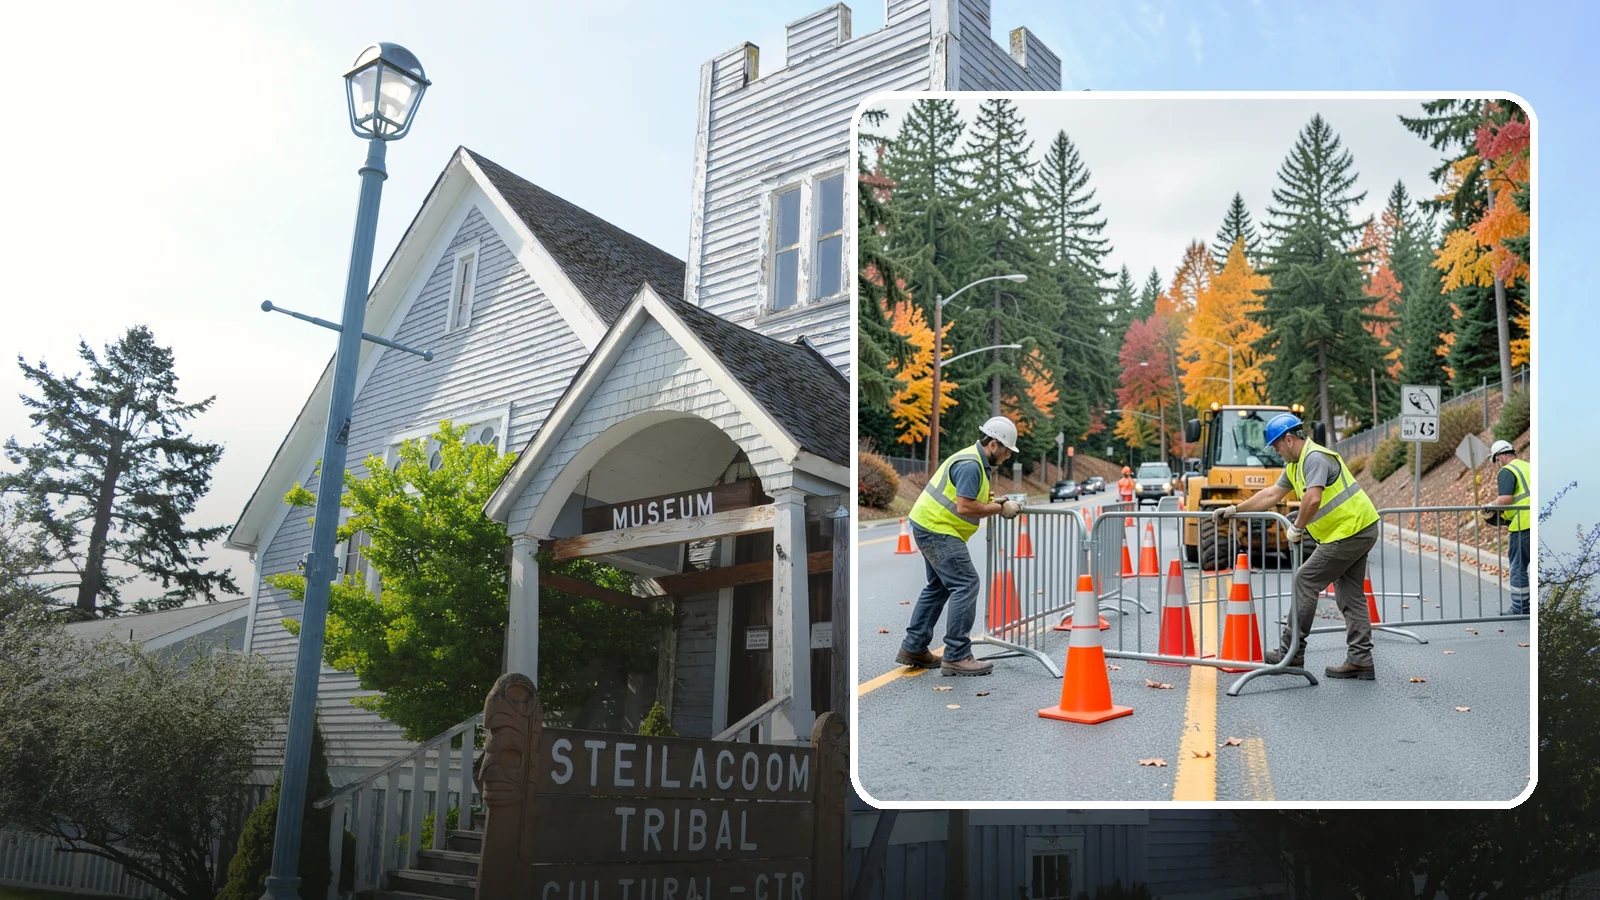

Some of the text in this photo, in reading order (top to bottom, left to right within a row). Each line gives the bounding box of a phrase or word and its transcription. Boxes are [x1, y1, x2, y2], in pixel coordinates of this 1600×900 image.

[613, 491, 714, 531] MUSEUM
[550, 738, 810, 792] STEILACOOM
[615, 806, 758, 851] TRIBAL
